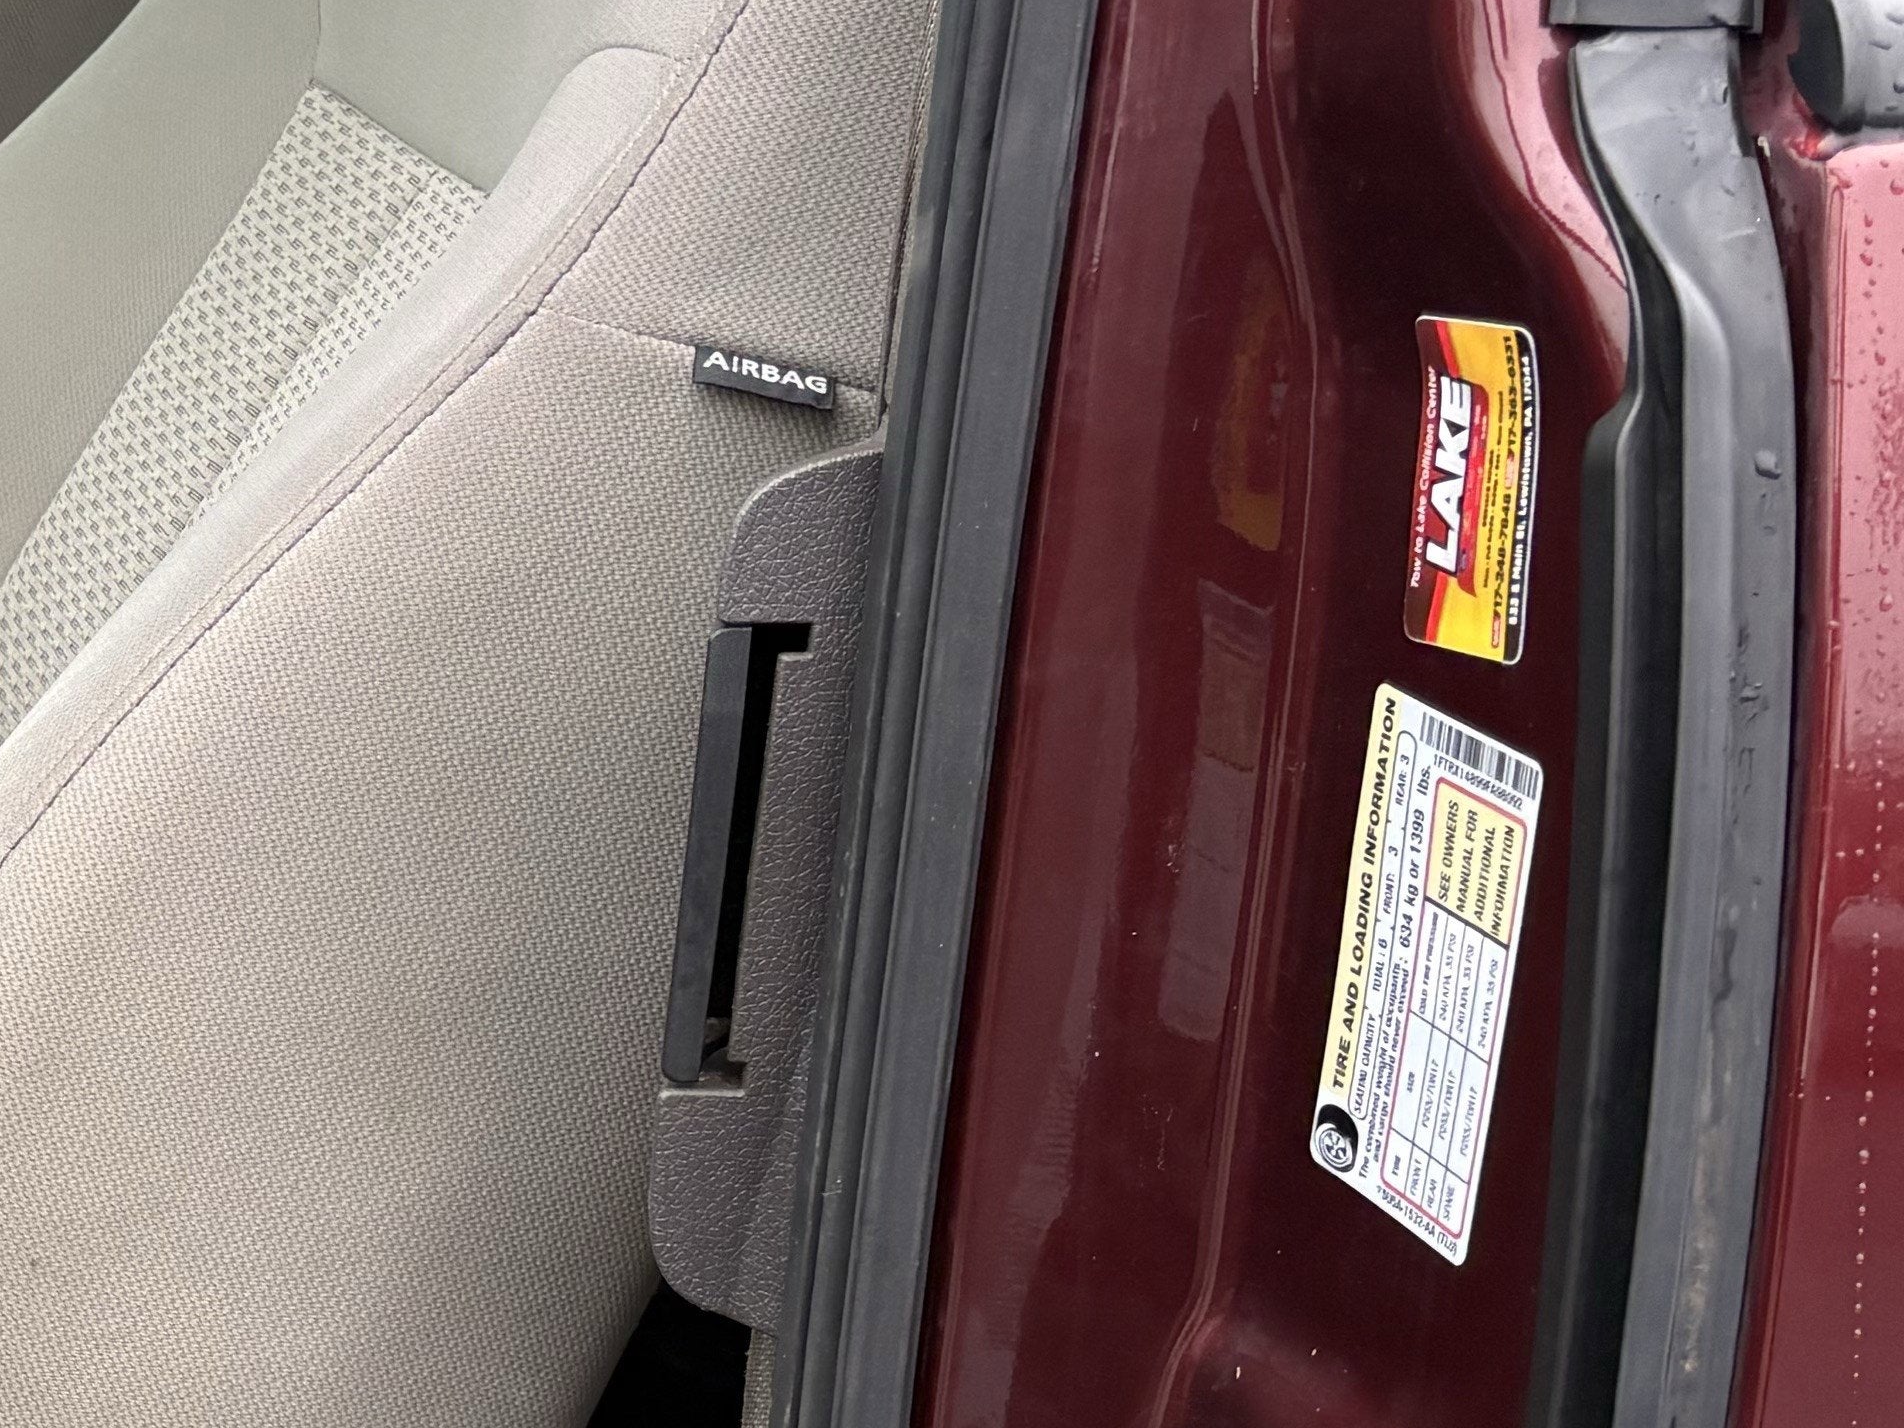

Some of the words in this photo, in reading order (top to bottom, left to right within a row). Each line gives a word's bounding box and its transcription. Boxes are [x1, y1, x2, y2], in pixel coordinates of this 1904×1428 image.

[702, 351, 828, 395] AIRBAG
[1426, 365, 1437, 420] Center
[1419, 423, 1435, 491] Collision
[1425, 376, 1472, 572] LAKE
[1415, 494, 1428, 533] Lake
[1511, 543, 1524, 580] Main
[1523, 406, 1533, 428] PA
[1413, 536, 1424, 554] to
[1410, 556, 1422, 588] Tow
[1363, 697, 1397, 866] INFORMATION
[1400, 754, 1410, 766] 3
[1409, 808, 1425, 854] 1399
[1442, 799, 1459, 869] OWNERS
[1464, 809, 1478, 843] FOR
[1388, 845, 1399, 857] 3
[1409, 858, 1420, 880] or
[1403, 883, 1419, 907] kg
[1438, 871, 1451, 903] SEE
[1455, 847, 1474, 913] MANUAL
[1473, 827, 1496, 922] ADDITIONAL
[1490, 825, 1515, 937] INFORMATION
[1349, 872, 1373, 977] LOADING
[1399, 913, 1414, 949] 634
[1342, 981, 1359, 1033] AND
[1332, 1035, 1351, 1089] TIRE
[1358, 1155, 1370, 1179] The
